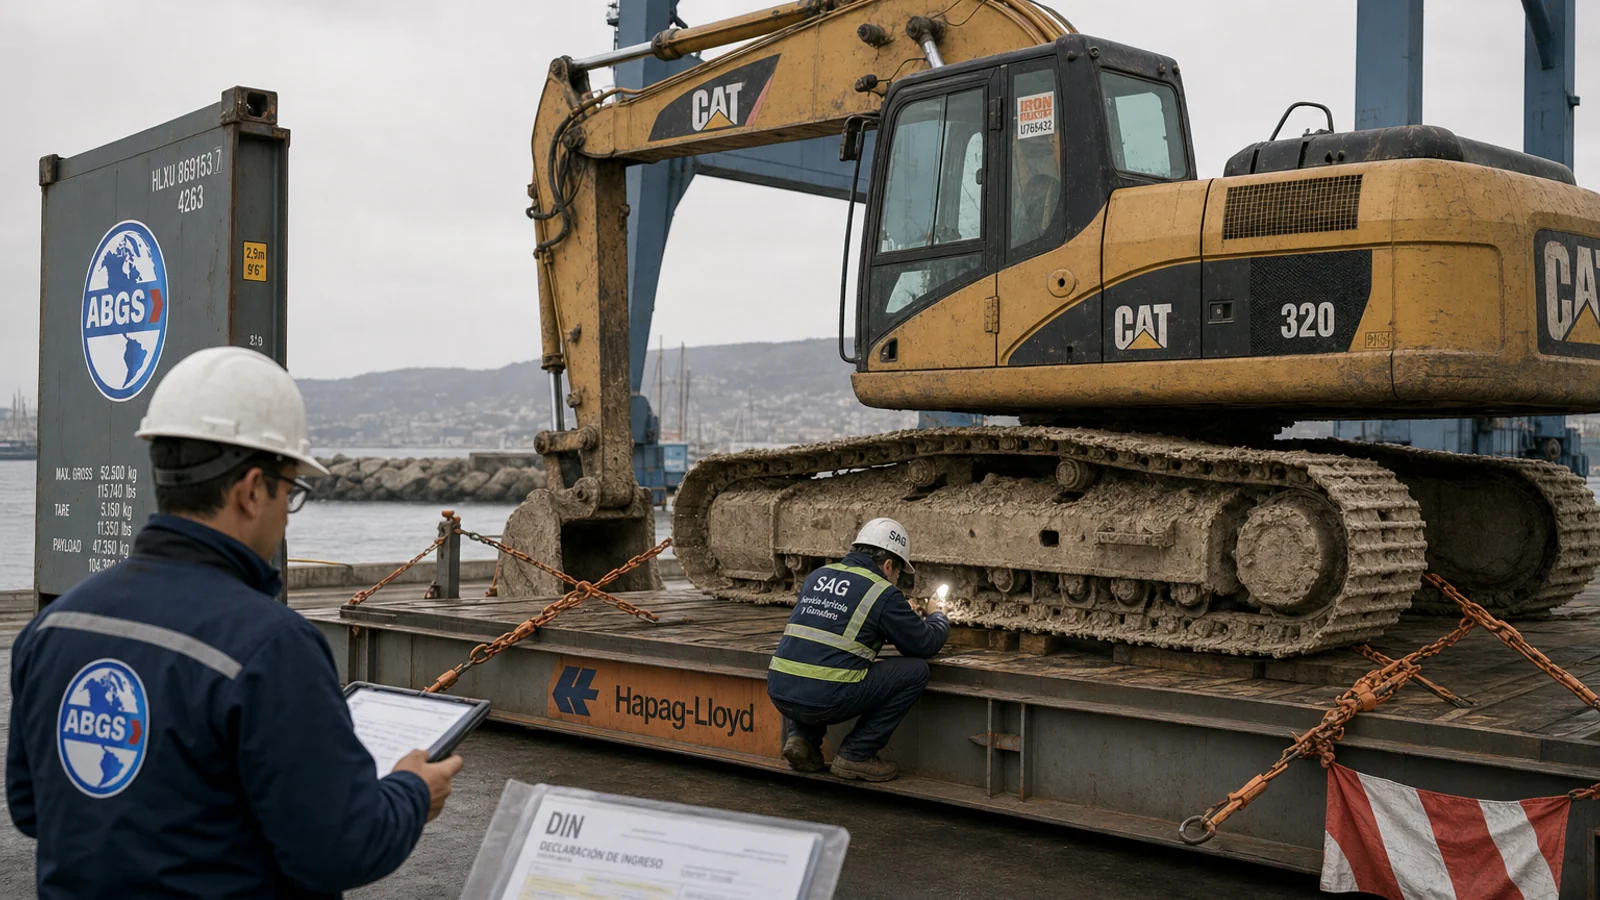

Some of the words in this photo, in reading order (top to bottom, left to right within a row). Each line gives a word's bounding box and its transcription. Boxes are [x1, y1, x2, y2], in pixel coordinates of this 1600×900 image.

[692, 82, 743, 131] CAT
[1020, 95, 1053, 112] IRON
[152, 164, 175, 192] HLXU
[178, 152, 212, 184] 869153
[215, 148, 221, 172] 7
[178, 184, 204, 213] 4263
[86, 288, 145, 329] ABGS
[1280, 301, 1335, 339] 320
[1114, 303, 1172, 350] CAT
[72, 467, 93, 480] GROSS
[128, 465, 137, 483] kg
[125, 483, 136, 498] lbs
[54, 503, 70, 517] TARE
[122, 502, 132, 521] kg
[121, 521, 132, 536] lbs
[888, 530, 907, 547] SAG
[53, 537, 82, 553] PAYLOAD
[119, 540, 129, 559] kg
[813, 576, 851, 597] SAG
[615, 684, 755, 737] Hapag-Lloyd
[63, 708, 126, 742] ABGS
[545, 811, 586, 839] DIN
[605, 850, 620, 863] DE
[620, 853, 664, 869] INGRESO
